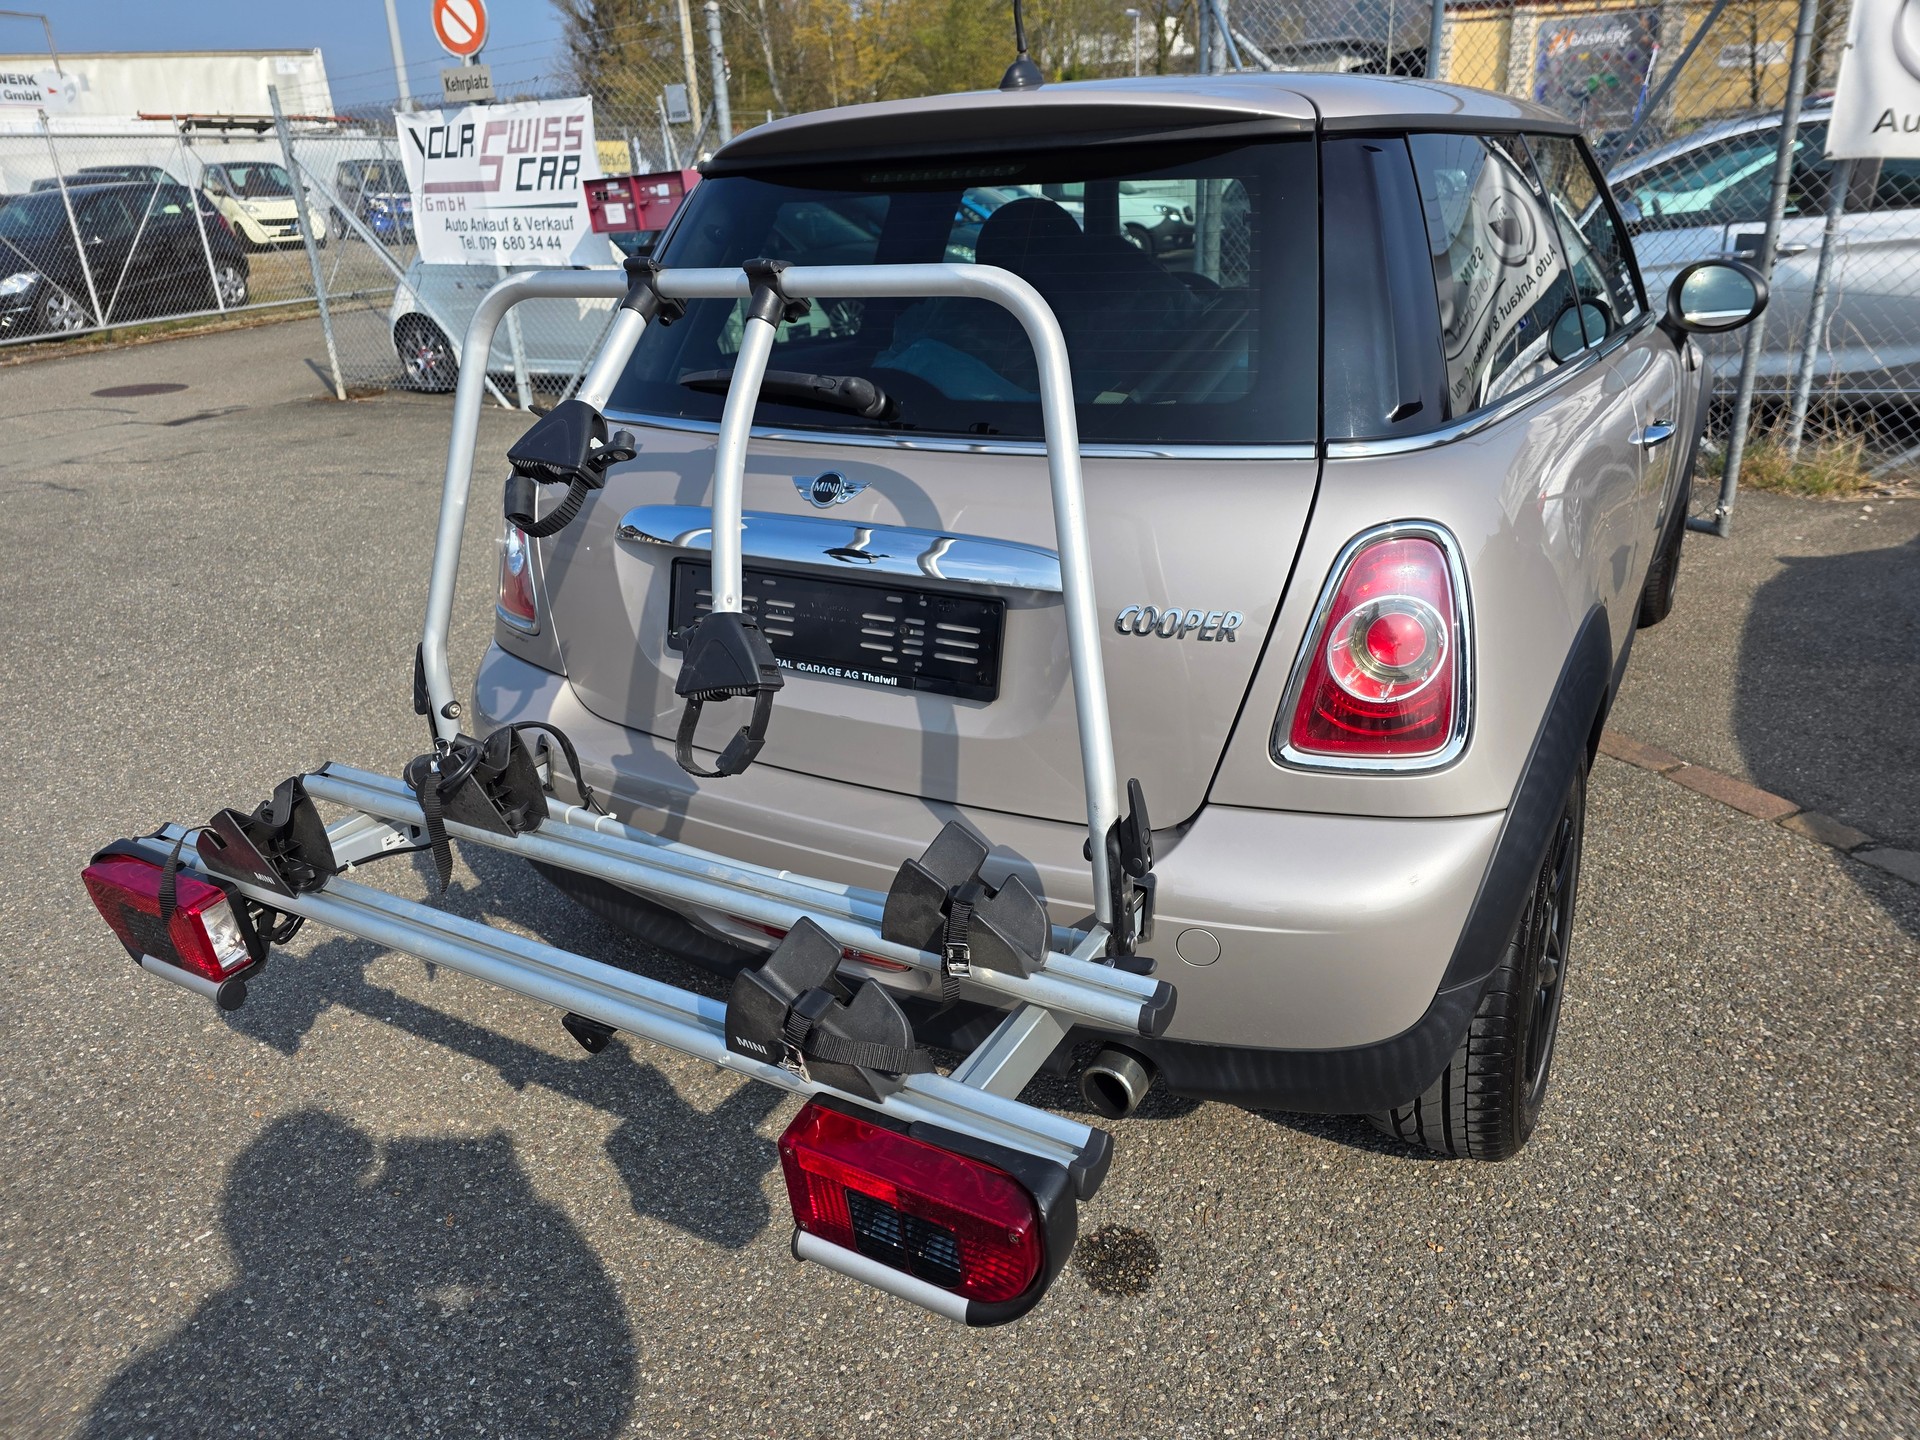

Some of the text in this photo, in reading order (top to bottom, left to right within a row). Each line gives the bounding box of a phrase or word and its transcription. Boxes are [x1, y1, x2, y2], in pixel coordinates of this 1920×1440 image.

[444, 74, 490, 95] Kehrplatz
[3, 89, 42, 101] GmbH
[516, 155, 580, 191] CAR
[425, 196, 466, 212] GmbH
[445, 215, 574, 232] Auto Ankauf & Verkauf
[502, 235, 526, 250] 680
[530, 235, 543, 250] 34
[547, 235, 561, 250] 44
[813, 481, 840, 494] MINI
[1114, 604, 1245, 642] COOPER
[799, 662, 842, 678] GARAGE
[843, 669, 859, 680] AG
[735, 1035, 768, 1055] MINI
